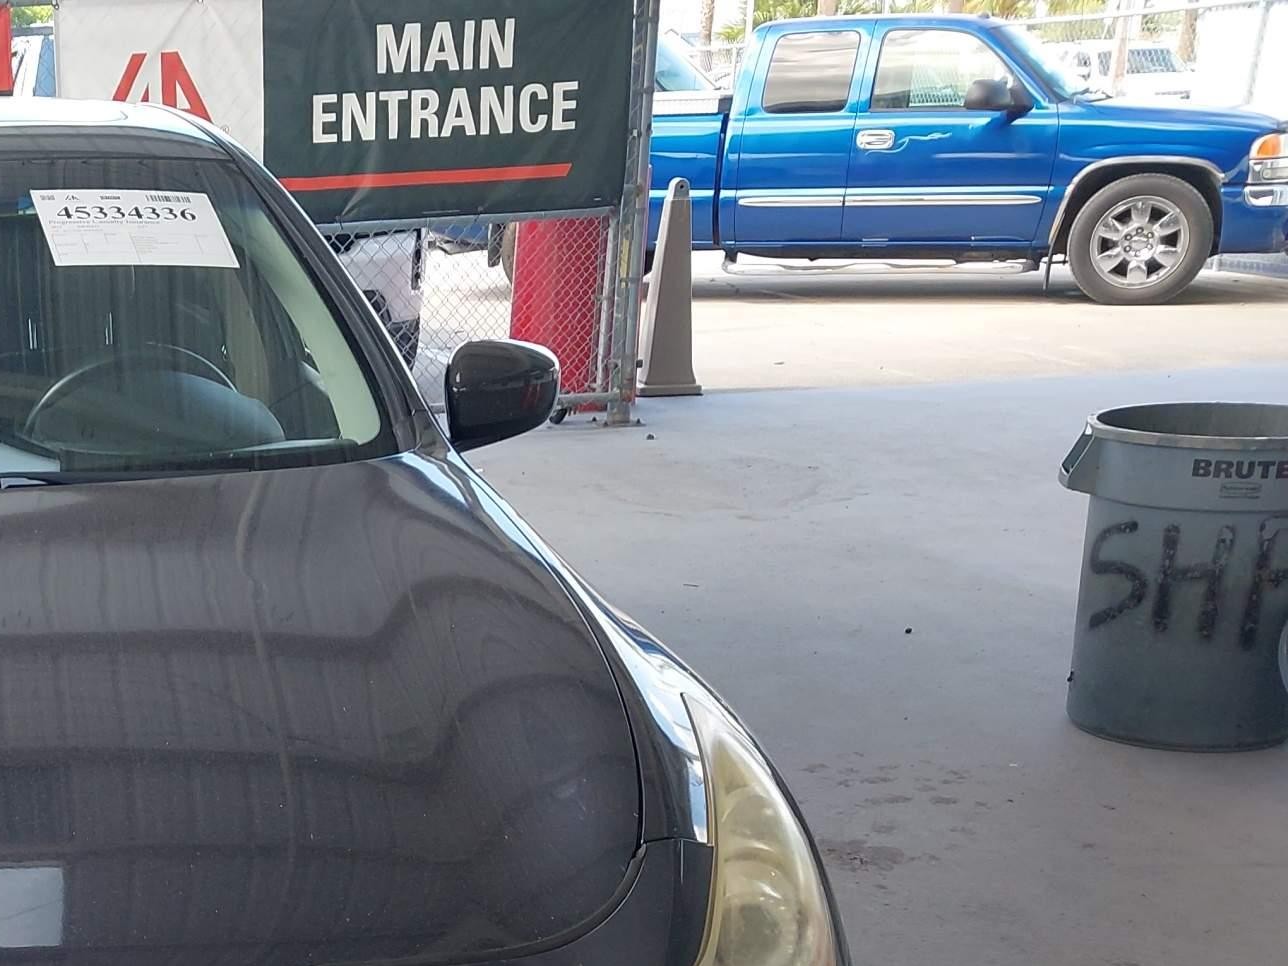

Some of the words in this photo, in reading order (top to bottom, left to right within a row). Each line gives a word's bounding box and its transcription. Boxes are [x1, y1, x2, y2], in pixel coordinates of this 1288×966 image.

[376, 18, 516, 75] MAIN
[312, 81, 580, 144] ENTRANCE
[57, 205, 197, 221] 45334336
[1192, 458, 1288, 479] BRUTE
